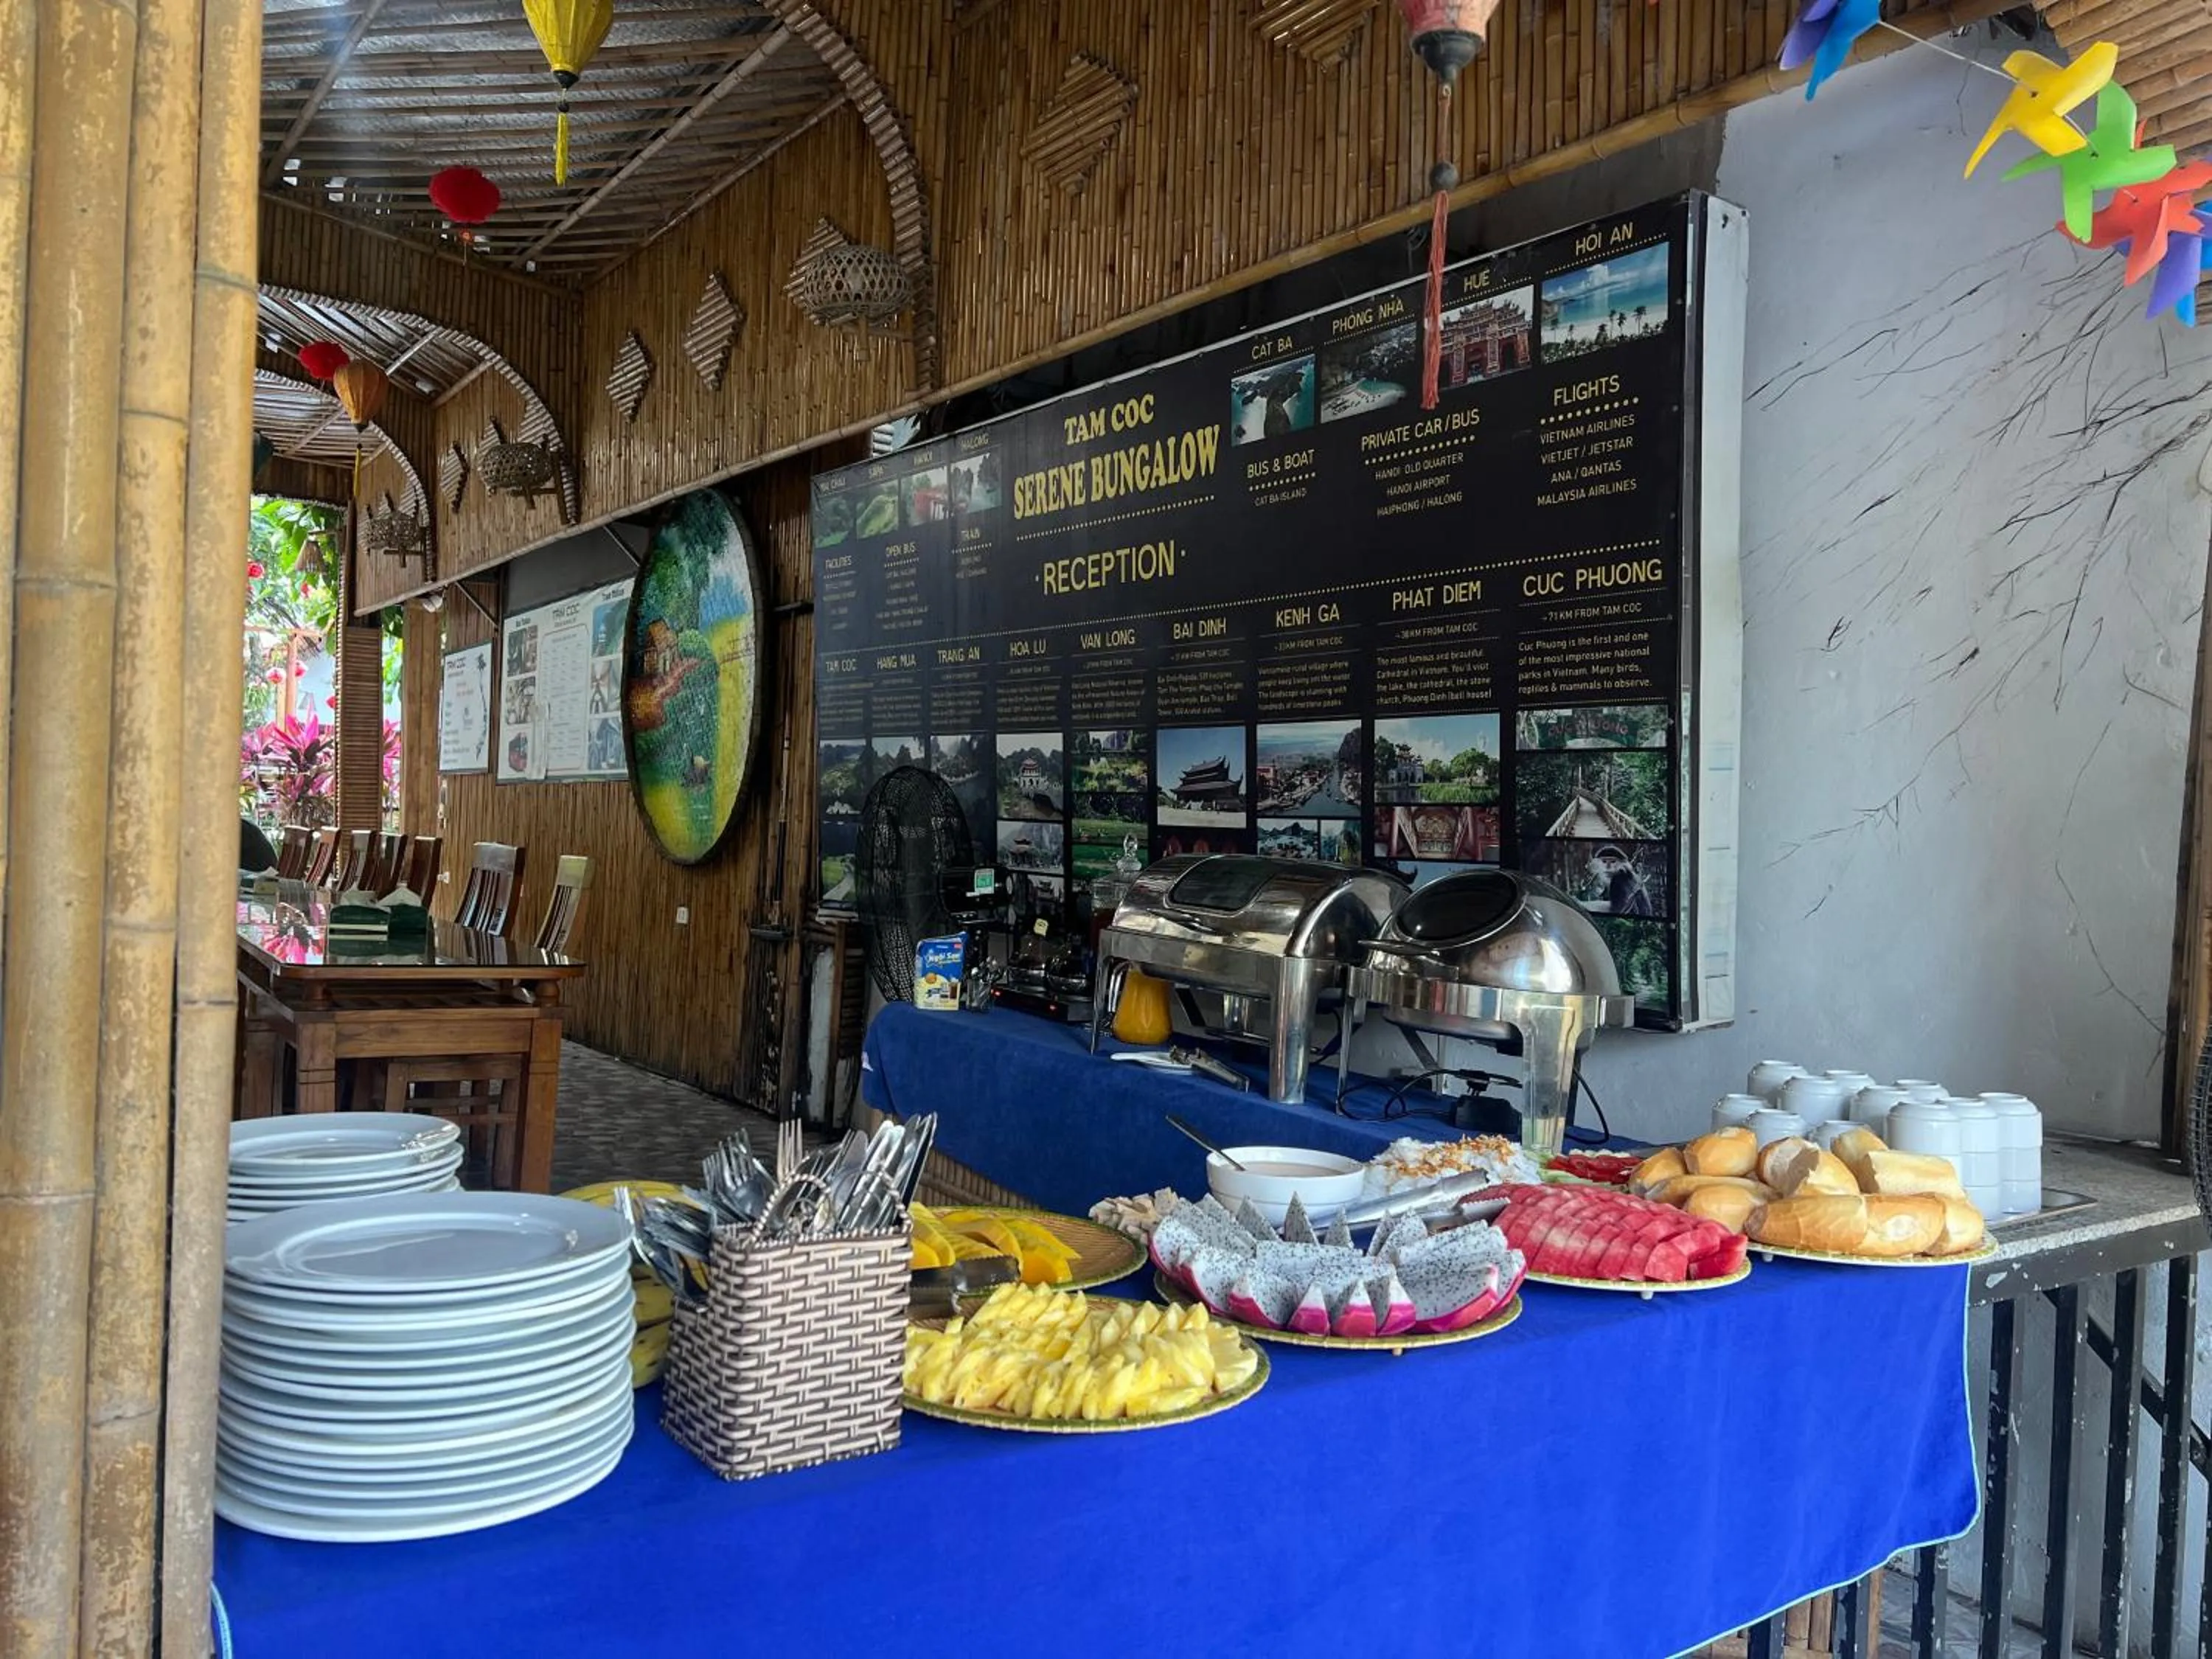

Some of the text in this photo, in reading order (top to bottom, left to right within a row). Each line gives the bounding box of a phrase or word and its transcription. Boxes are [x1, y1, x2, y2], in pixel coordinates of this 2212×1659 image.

[1576, 221, 1633, 257] HOI AN
[1252, 336, 1293, 360] CAT BA
[1554, 374, 1620, 406] FLIGHTS
[1064, 394, 1155, 445] TAM COC
[1540, 414, 1635, 445] VIETNAM AIRLINES
[1361, 425, 1411, 452] PRIVATE
[1540, 447, 1579, 465] VIETJET
[1588, 436, 1633, 456] JETSTAR
[1014, 424, 1220, 521] SERENE BUNGALOW
[1247, 448, 1315, 479] BUS & BOAT
[1375, 452, 1464, 481] HANOI OLD QUARTER
[1551, 470, 1571, 483] ANA
[1580, 459, 1621, 478] QANTAS
[1387, 474, 1450, 497] HANOI AIRPORT
[1537, 479, 1638, 507] MALAYSIA AIRLINES
[1254, 495, 1268, 507] CAT
[1270, 493, 1279, 504] BA
[1377, 498, 1419, 518] HAIPHONG
[1427, 492, 1463, 508] HALONG
[903, 542, 916, 554] BUS
[1043, 539, 1175, 597] RECEPTION
[1523, 558, 1662, 597] CUC PHUONG
[1393, 580, 1481, 611] PHAT DIEM
[1276, 602, 1340, 628] KENH GA
[1574, 608, 1599, 619] FROM
[1601, 605, 1621, 616] TAM
[1623, 602, 1643, 613] COC
[1080, 628, 1136, 650] VAN LONG
[1173, 616, 1226, 640] BAI DINH
[1422, 626, 1444, 636] FROM
[1446, 624, 1461, 633] TAM
[1462, 622, 1478, 632] COC
[1009, 638, 1047, 658] HOA LU
[1519, 632, 1649, 651] Cuc Phuong is the first and one
[841, 658, 857, 672] COC
[877, 653, 917, 670] HANG MUA
[937, 646, 981, 664] TRANG AN
[1518, 645, 1650, 666] of the most impressive national
[1518, 669, 1542, 681] parks
[1543, 669, 1551, 678] in
[1592, 664, 1615, 675] Many
[1518, 684, 1549, 695] reptiles
[1551, 682, 1557, 692] &
[1559, 679, 1601, 691] mammals
[1604, 678, 1613, 688] to
